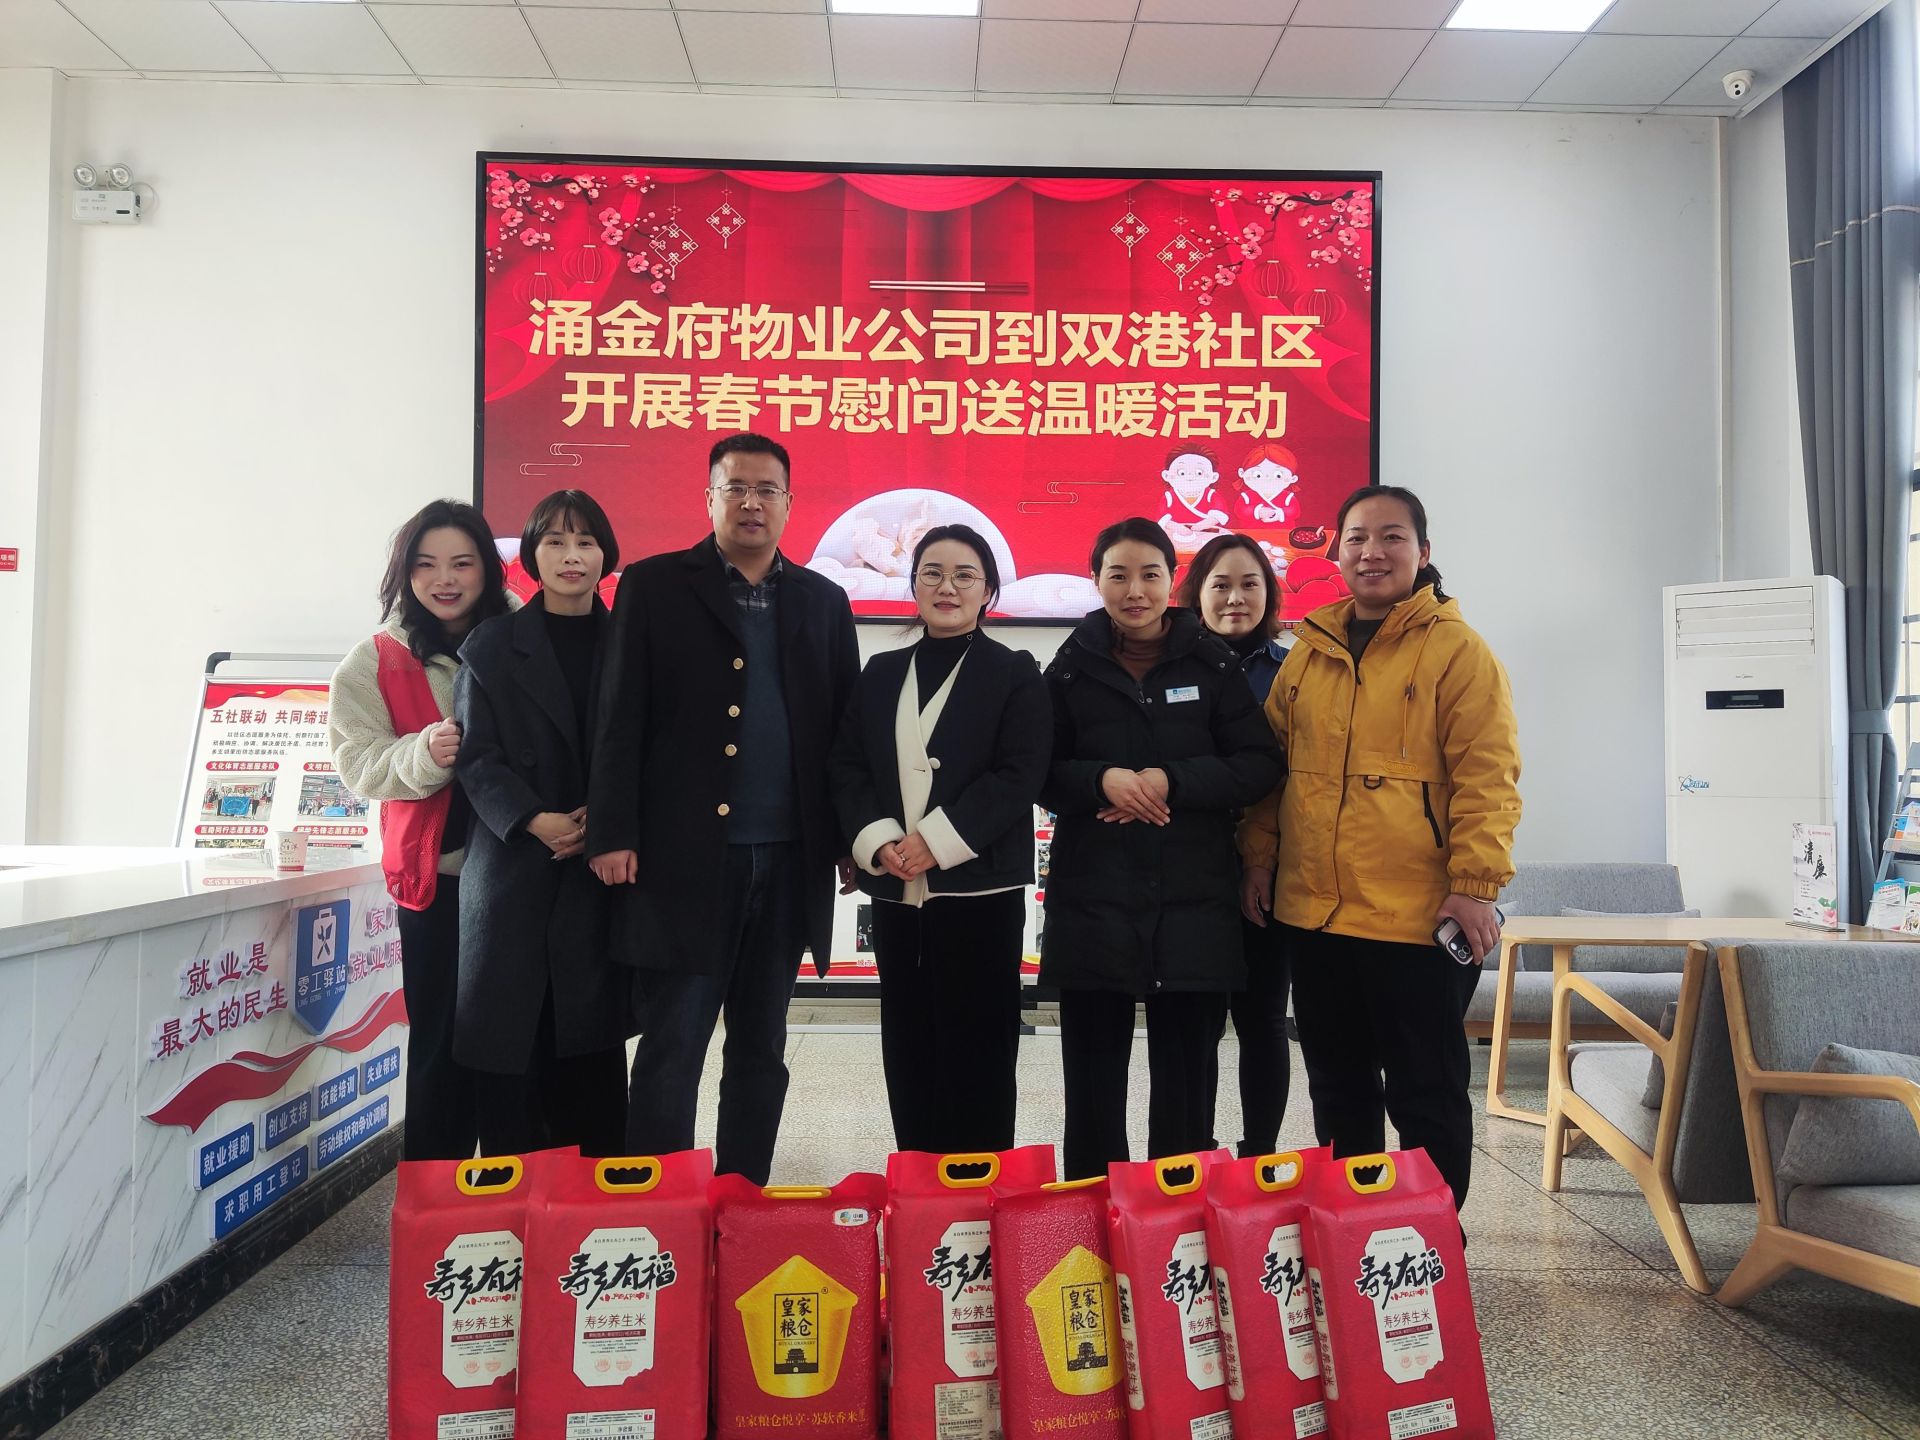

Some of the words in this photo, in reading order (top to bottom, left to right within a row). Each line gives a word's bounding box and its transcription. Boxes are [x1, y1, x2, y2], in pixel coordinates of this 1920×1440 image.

[528, 297, 1323, 370] 涌金府物业公司到双港社区
[562, 371, 1288, 439] 开展春节慰问送温暖活动
[210, 709, 267, 724] 五社联动
[306, 762, 334, 771] 文明创
[186, 941, 269, 998] 就业是
[297, 964, 346, 996] 零工驿站
[157, 980, 288, 1059] 最大的民生
[367, 1053, 397, 1083] 失业帮扶
[320, 1076, 355, 1110] 技能培训
[268, 1101, 307, 1138] 创业支持
[319, 1108, 388, 1161] 劳动维权和争议调解
[203, 1138, 250, 1176] 就业援助
[224, 1156, 301, 1224] 求职用工登记
[781, 1297, 812, 1317] 皇家
[1069, 1288, 1098, 1311] 皇家
[452, 1314, 514, 1332] 寿乡养生米
[585, 1312, 646, 1329] 寿乡养生米
[780, 1318, 812, 1338] 粮仓
[1069, 1310, 1099, 1332] 粮仓
[1384, 1308, 1431, 1328] 寿乡养生米
